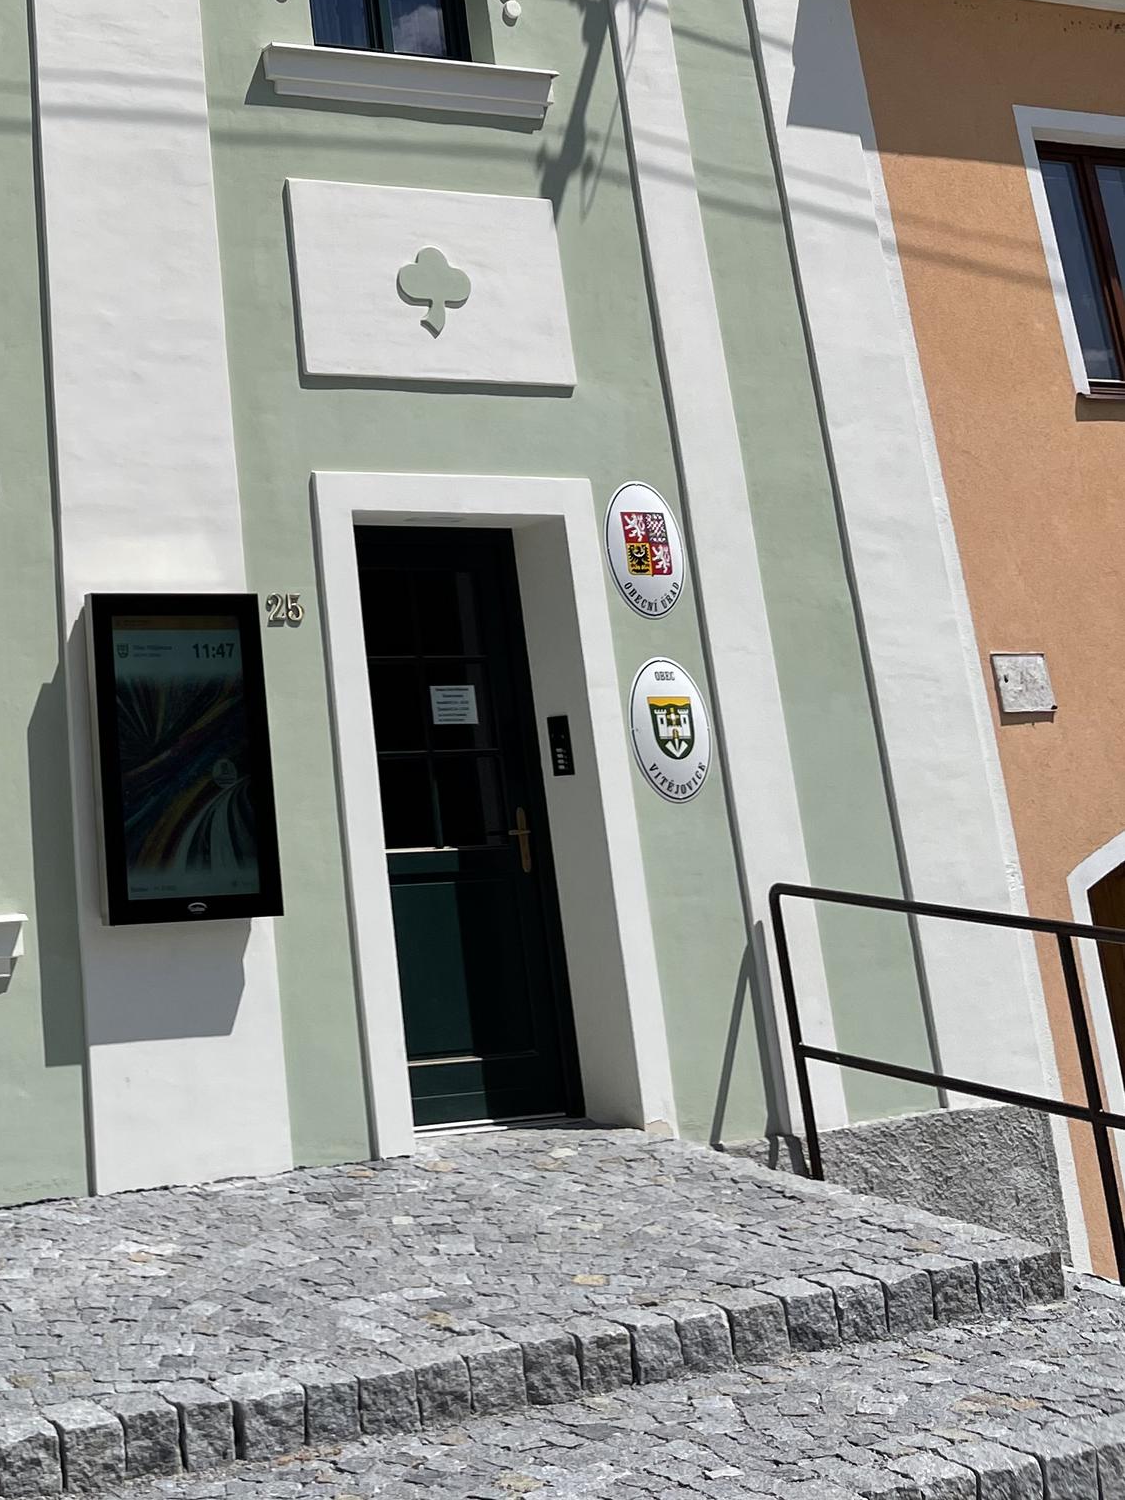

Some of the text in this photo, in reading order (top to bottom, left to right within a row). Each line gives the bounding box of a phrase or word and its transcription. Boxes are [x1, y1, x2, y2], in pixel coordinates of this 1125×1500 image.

[624, 582, 658, 612] OBECNÍ
[266, 593, 304, 627] 25
[192, 643, 235, 659] 11:47
[654, 671, 676, 681] OBEC
